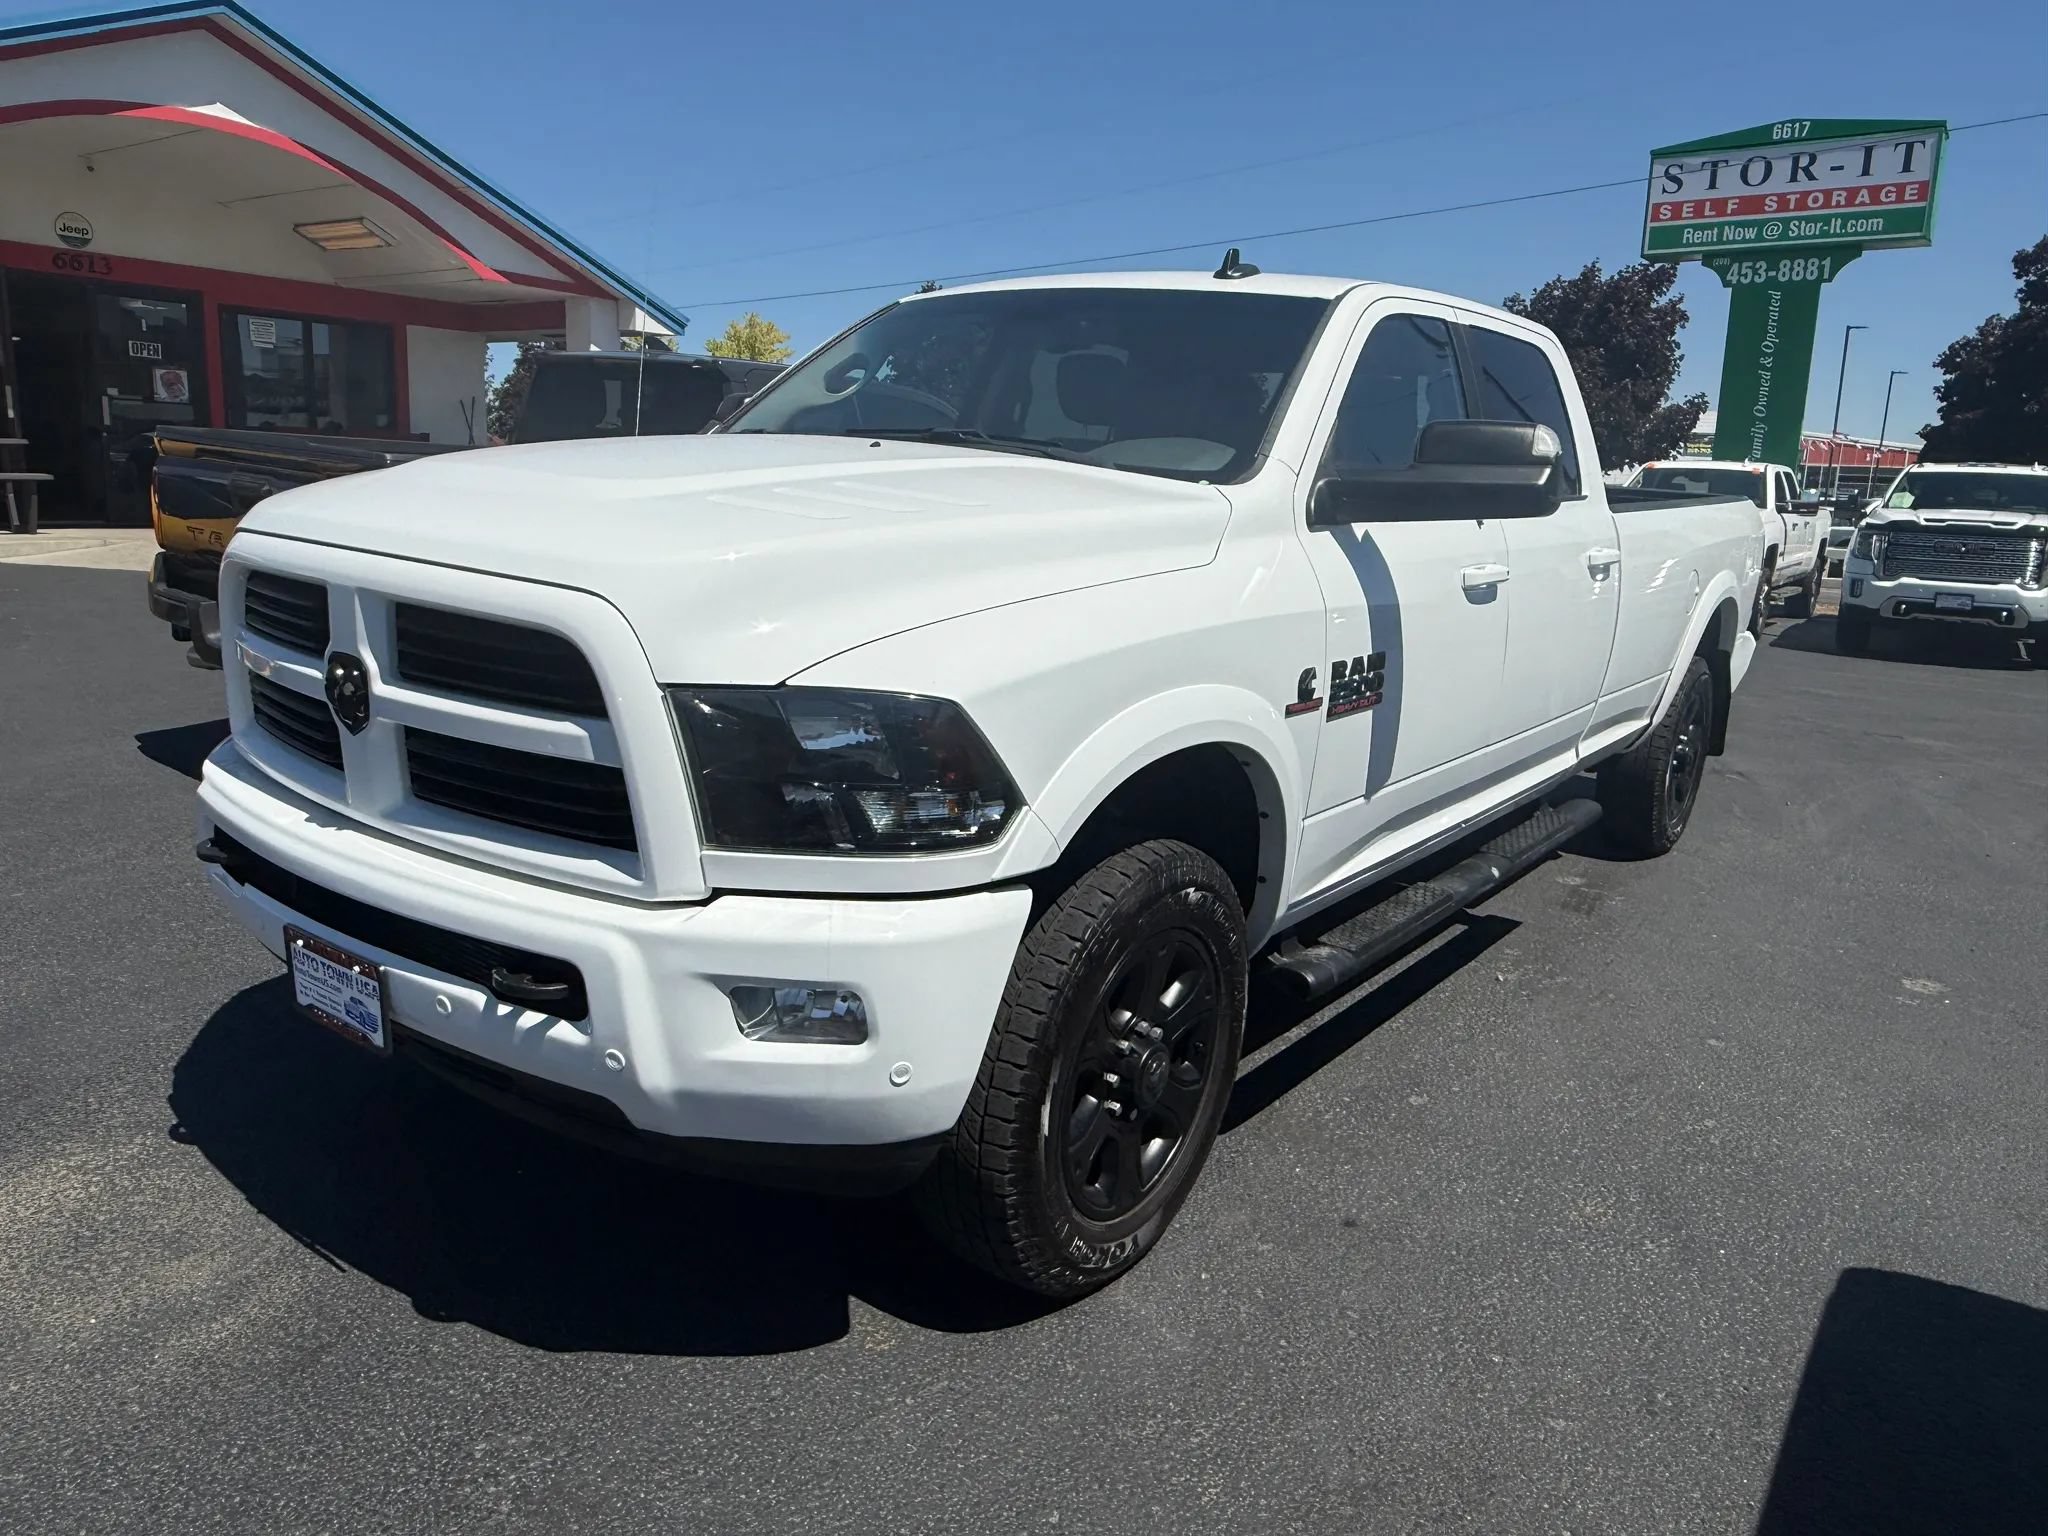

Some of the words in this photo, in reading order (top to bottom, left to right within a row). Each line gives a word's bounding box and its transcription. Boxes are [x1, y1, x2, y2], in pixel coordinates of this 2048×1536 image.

[1773, 121, 1811, 140] 6617
[1661, 140, 1926, 195] STOR-IT
[1659, 199, 1740, 221] SELF
[1764, 184, 1920, 212] STORAGE
[58, 222, 89, 237] Jeep
[1682, 227, 1718, 244] Rent
[1723, 224, 1757, 241] Now
[1763, 221, 1783, 239] @
[1789, 217, 1884, 237] Stor-It.com
[52, 252, 113, 276] 6613
[1726, 256, 1832, 284] 453-8881
[1760, 290, 1782, 353] Operated
[131, 341, 161, 358] OPEN
[1760, 356, 1773, 367] &
[1753, 370, 1772, 418] Owned
